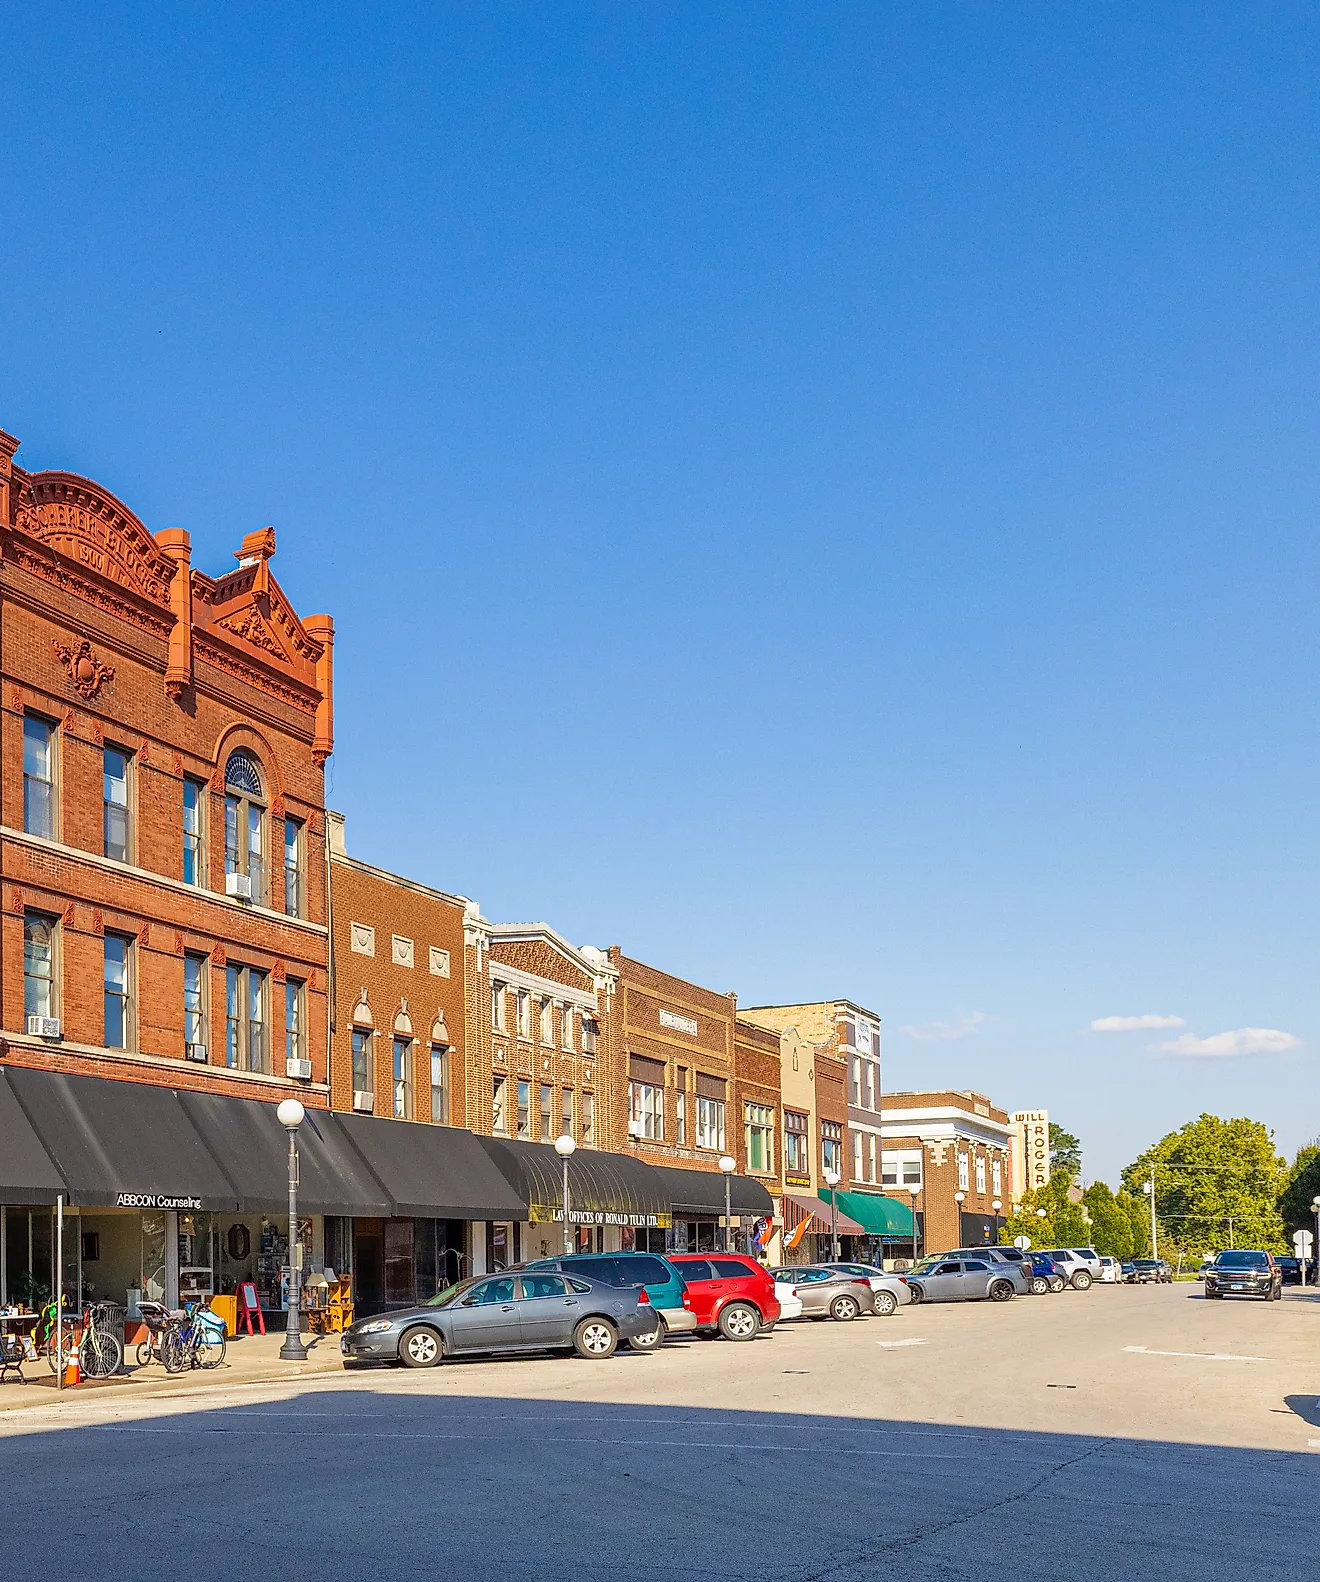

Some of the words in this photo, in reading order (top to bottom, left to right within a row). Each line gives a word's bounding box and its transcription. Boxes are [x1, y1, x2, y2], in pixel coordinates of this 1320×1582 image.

[1015, 1113, 1045, 1122] WILL
[1034, 1126, 1046, 1191] ROGER
[117, 1194, 156, 1206] ABBCON
[569, 1211, 594, 1224] OFFICES
[595, 1212, 604, 1224] OF
[606, 1213, 628, 1225] RONALD
[629, 1214, 646, 1226] TULIN
[646, 1216, 658, 1226] LTD.
